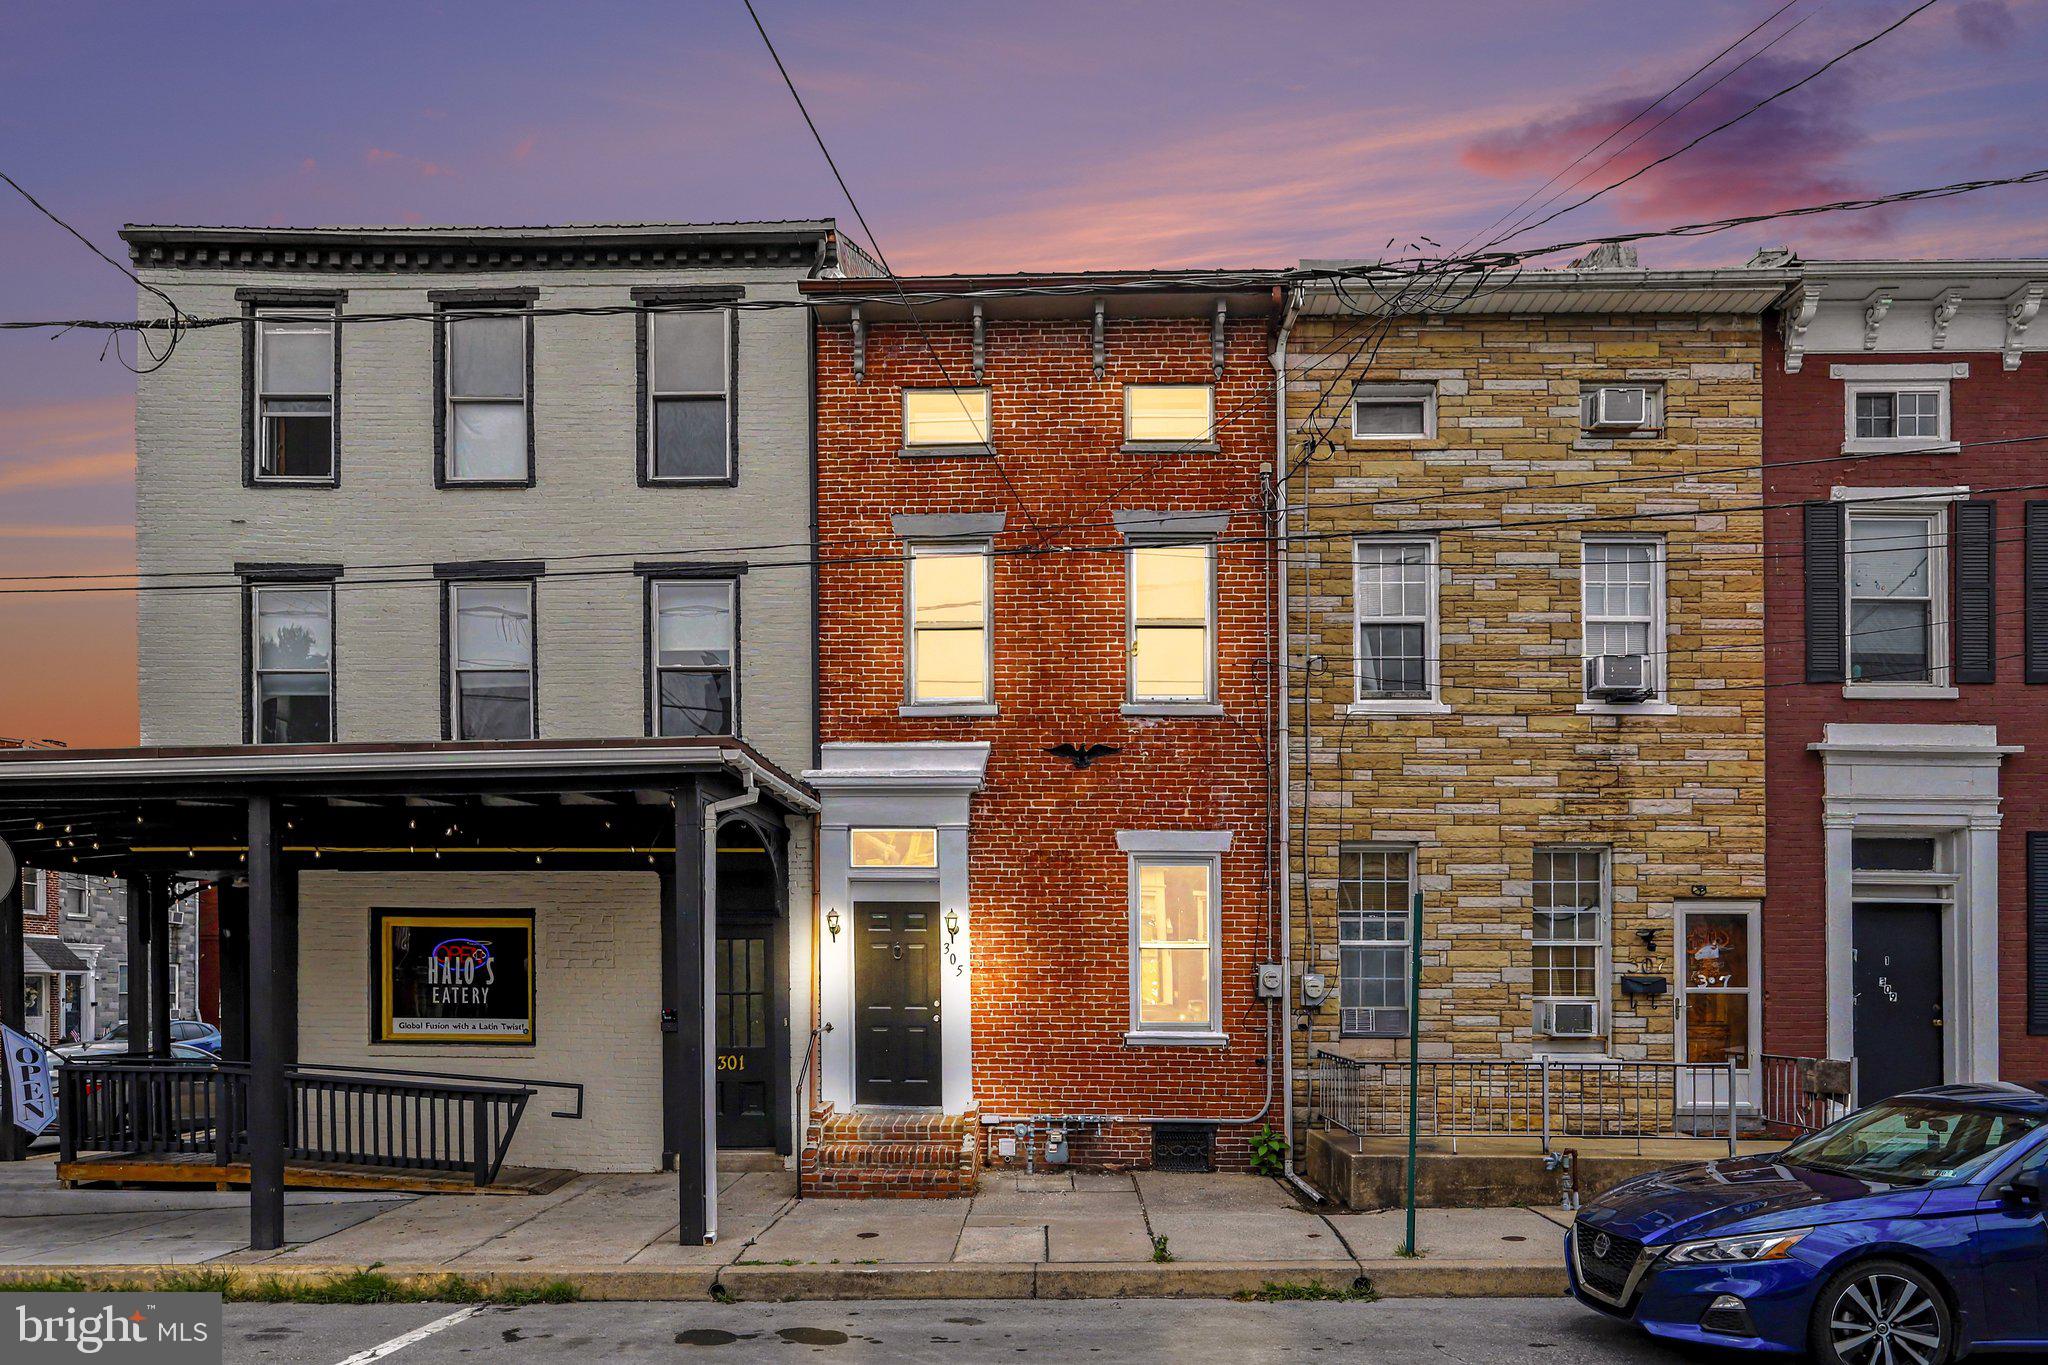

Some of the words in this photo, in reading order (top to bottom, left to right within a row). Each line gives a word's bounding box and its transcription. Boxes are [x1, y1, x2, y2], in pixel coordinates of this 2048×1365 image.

[943, 942, 964, 977] 305
[432, 987, 489, 1004] EATERY
[398, 1022, 423, 1030] Global
[425, 1022, 449, 1030] Fusion
[452, 1022, 469, 1030] with
[479, 1022, 499, 1031] Latin
[717, 1055, 745, 1071] 301
[15, 1047, 45, 1122] OPEN
